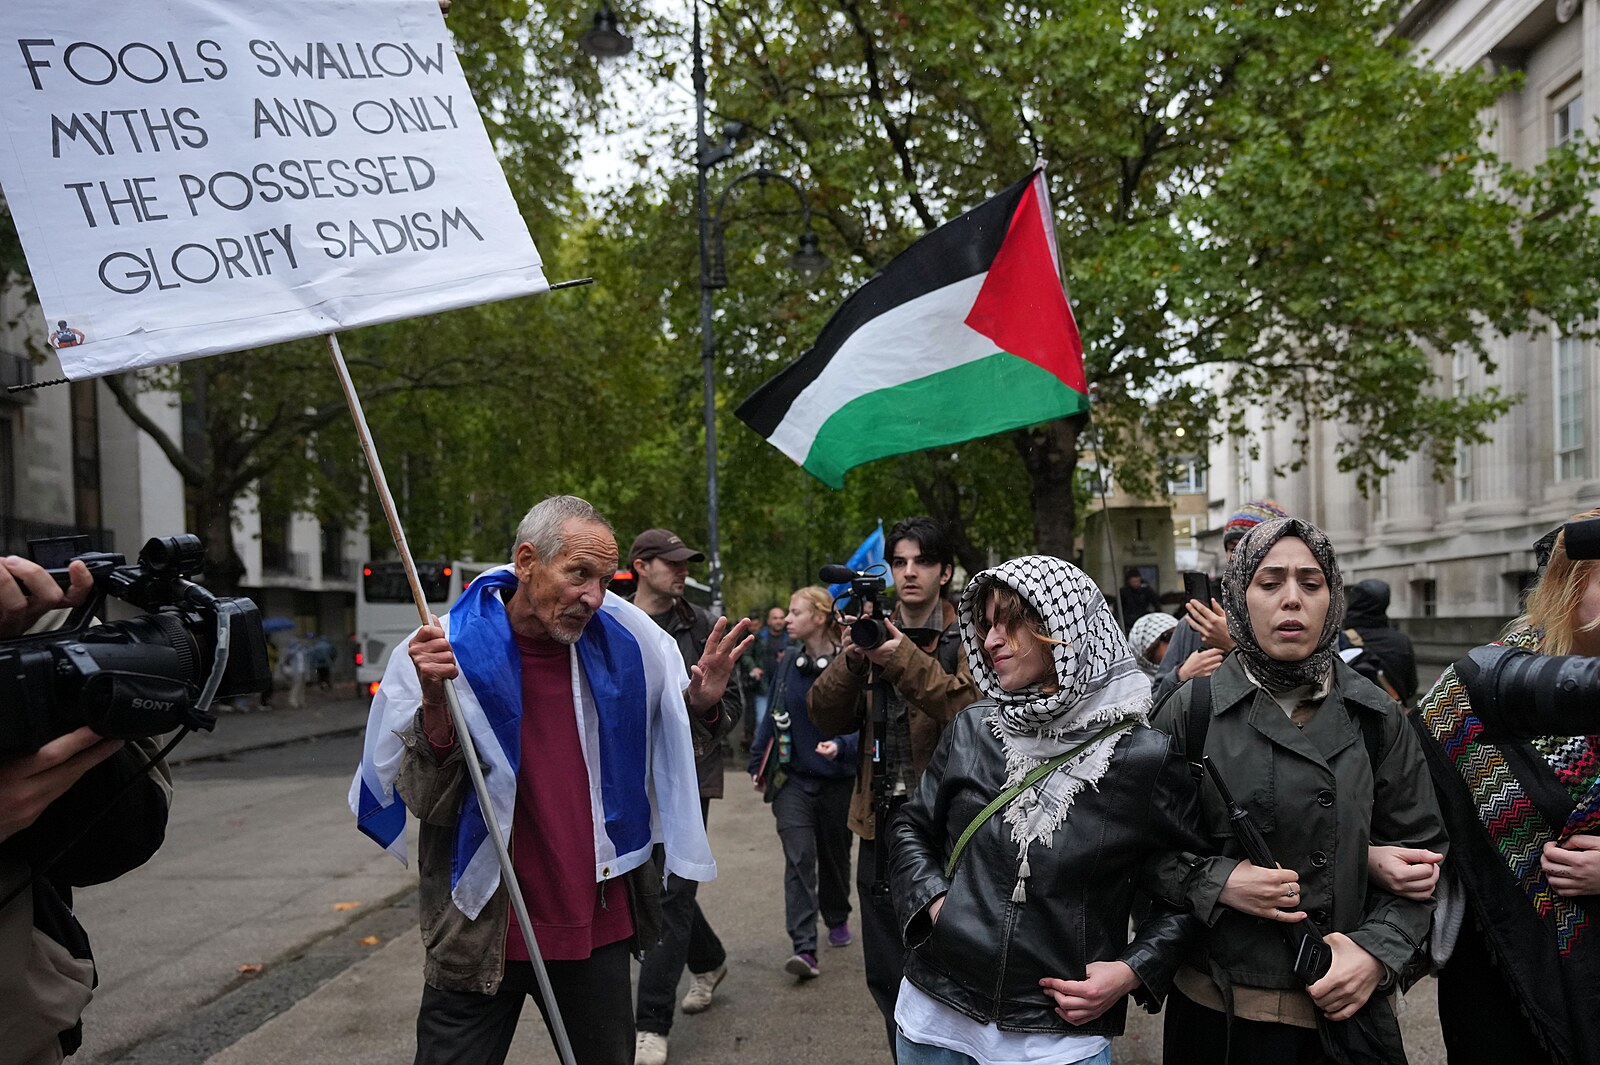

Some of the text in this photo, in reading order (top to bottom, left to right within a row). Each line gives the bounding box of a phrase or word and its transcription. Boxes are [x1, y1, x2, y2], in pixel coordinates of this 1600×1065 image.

[18, 39, 444, 91] FOOLS SWALLOW
[51, 95, 458, 158] MYTHS AND ONLY
[64, 156, 436, 228] THE POSSESSED
[98, 206, 485, 295] GLORIFY SADISM
[131, 697, 174, 711] SONY
